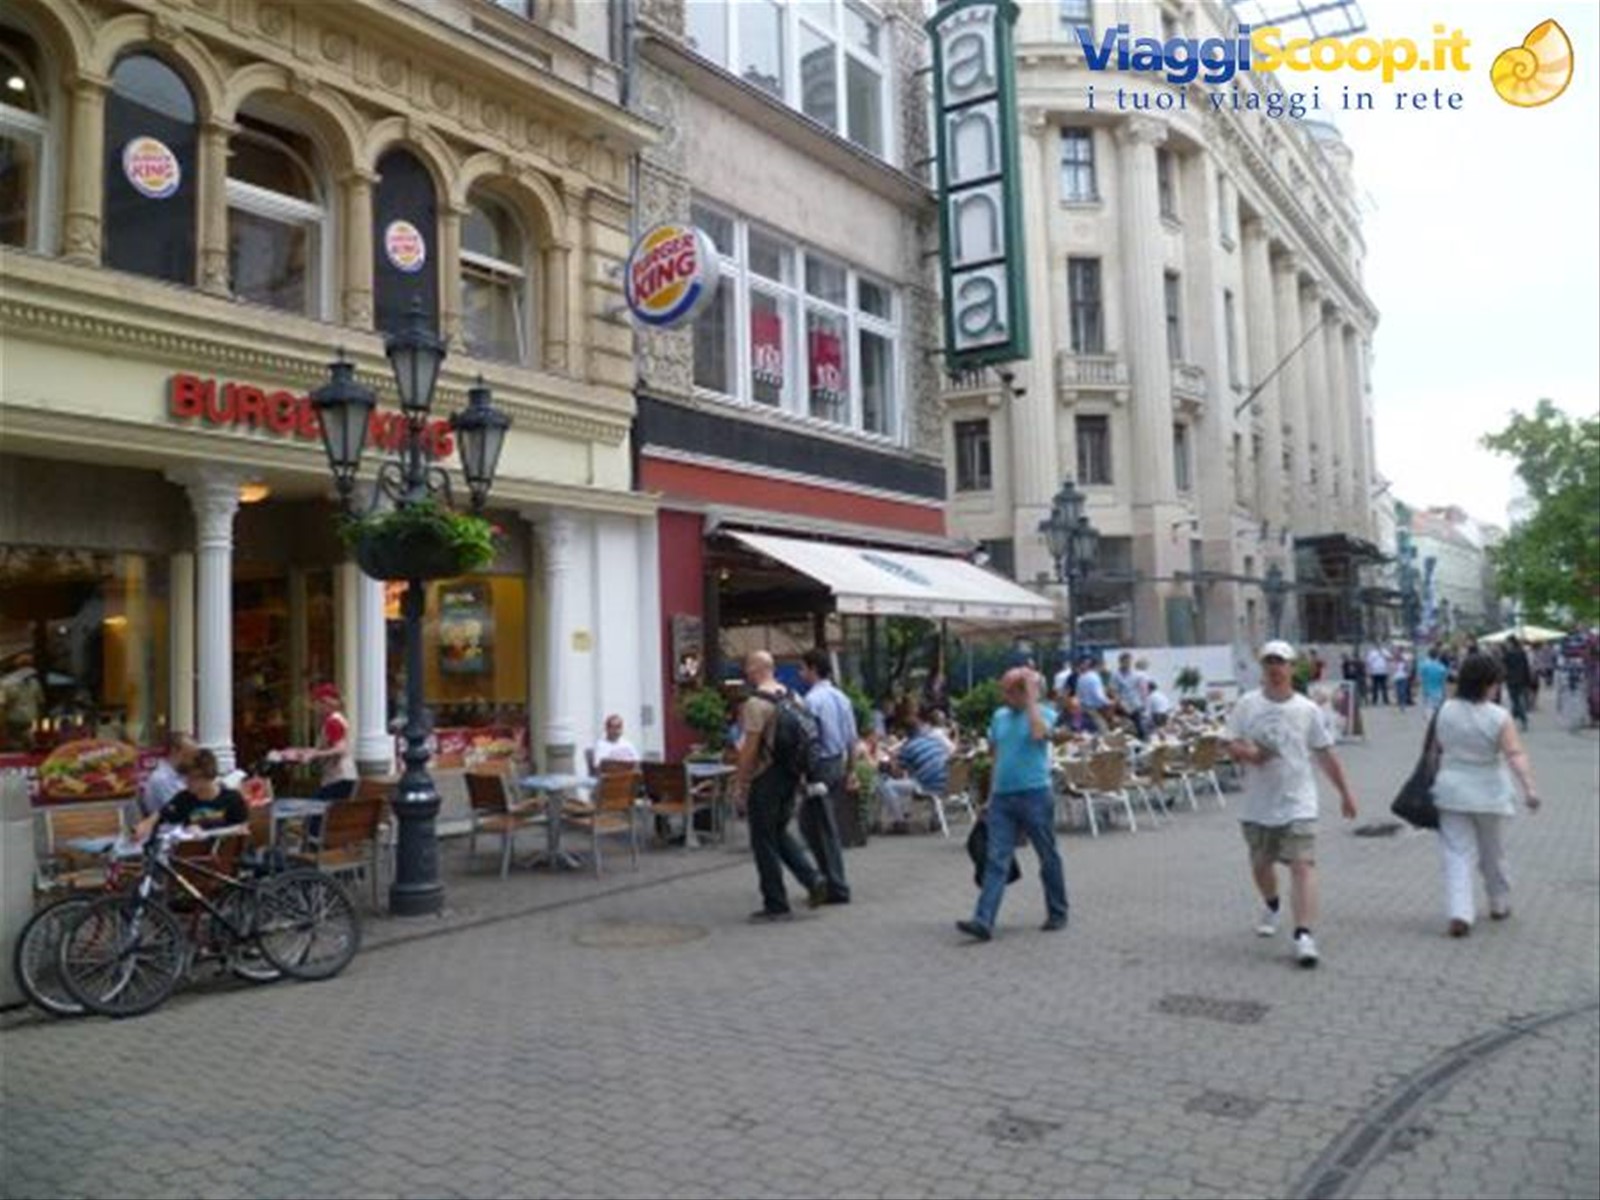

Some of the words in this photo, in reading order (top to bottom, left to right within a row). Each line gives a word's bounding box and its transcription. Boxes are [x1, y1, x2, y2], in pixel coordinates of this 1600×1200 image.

[633, 233, 694, 282] BURGER
[634, 250, 696, 306] KING
[170, 373, 325, 439] BURGE
